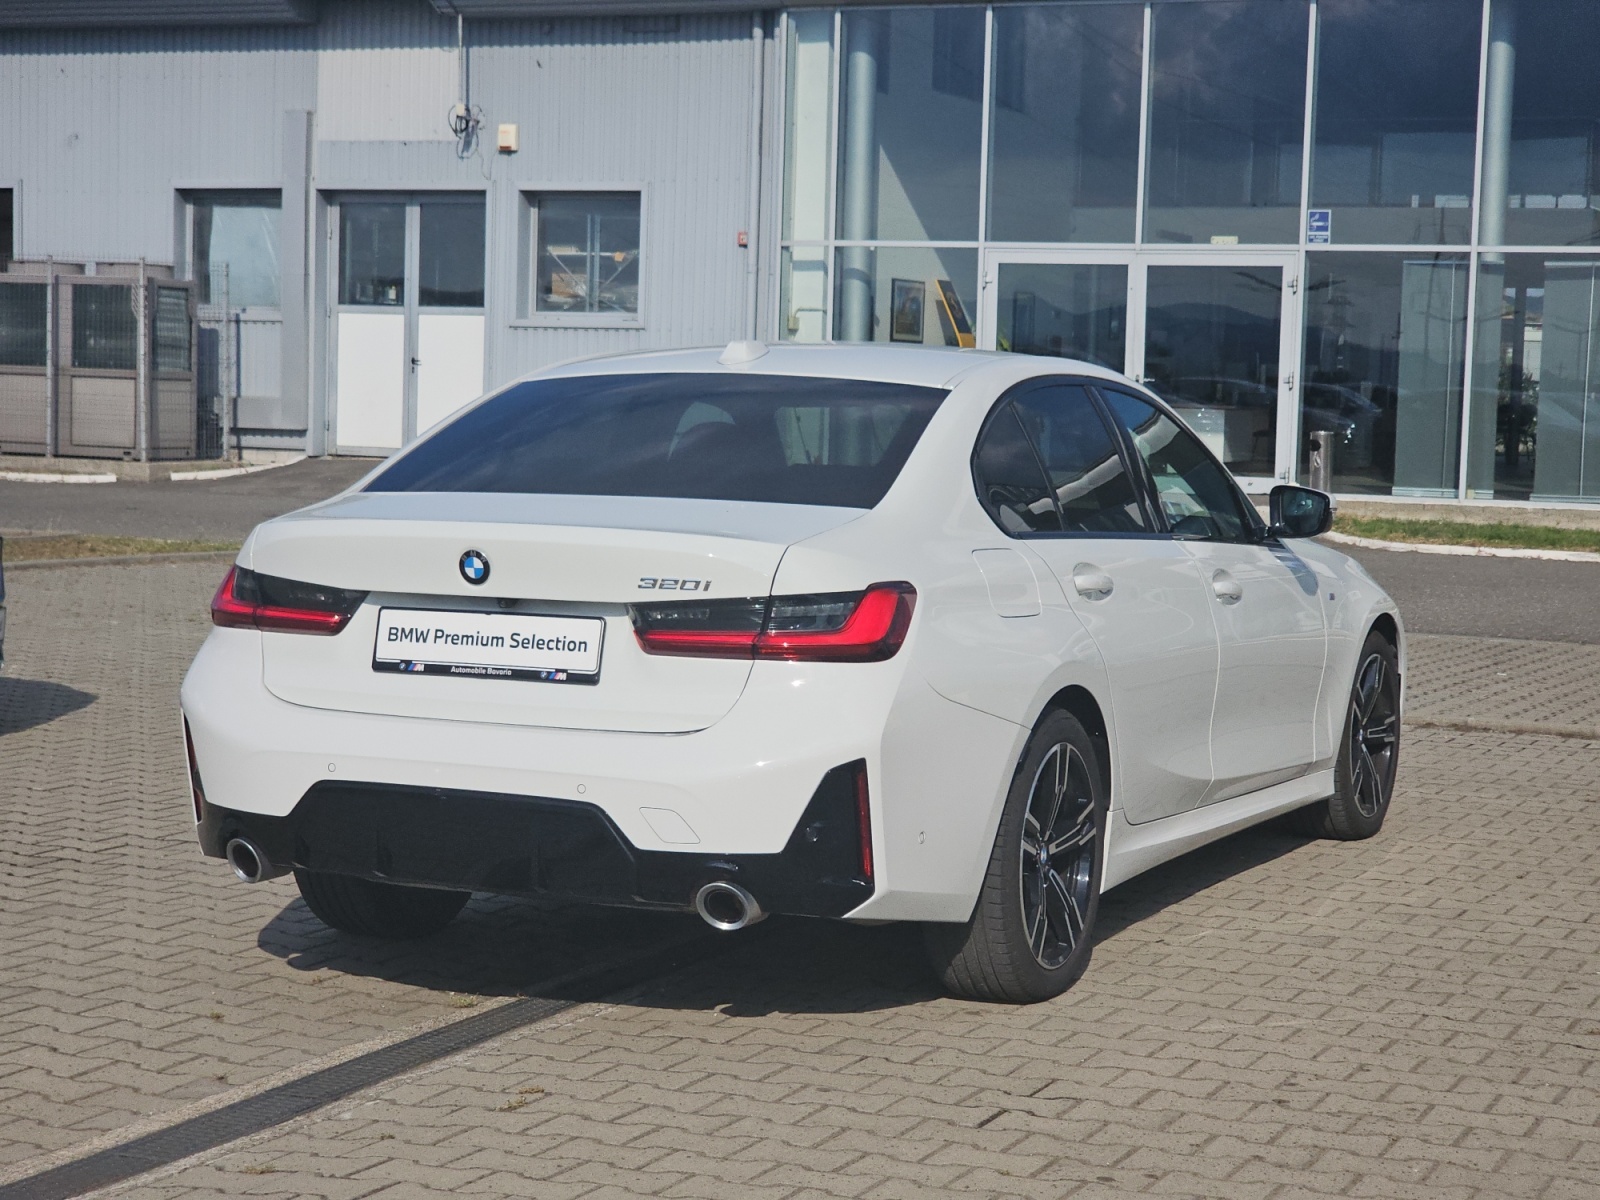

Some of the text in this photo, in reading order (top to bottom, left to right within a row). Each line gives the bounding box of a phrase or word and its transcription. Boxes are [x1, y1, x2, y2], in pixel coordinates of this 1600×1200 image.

[638, 577, 712, 592] 320i
[387, 626, 588, 653] BMW Premium Selection
[450, 665, 512, 676] Automobile Bavaria
